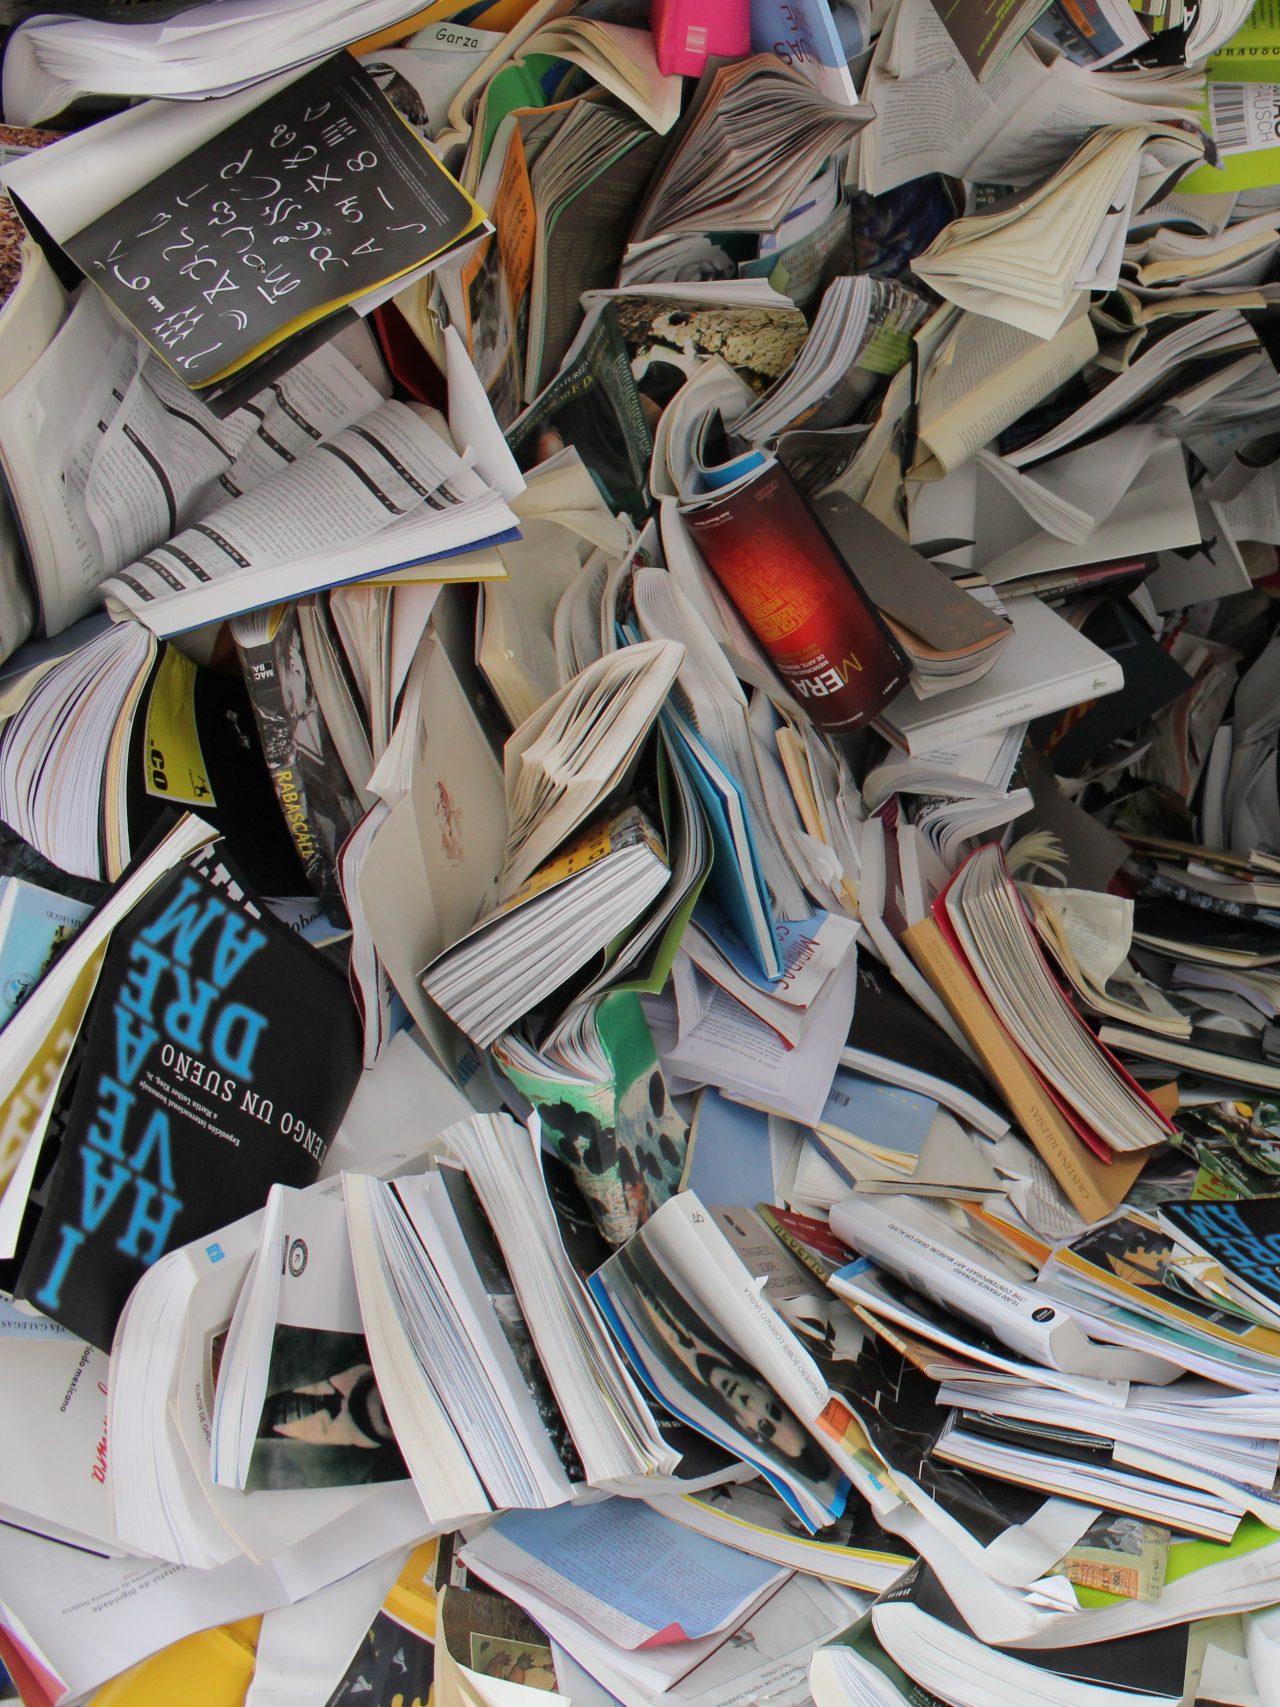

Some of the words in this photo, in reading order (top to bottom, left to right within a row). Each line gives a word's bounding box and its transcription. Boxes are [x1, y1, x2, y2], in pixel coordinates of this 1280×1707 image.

[434, 27, 479, 48] Garza
[252, 662, 265, 672] BA
[253, 668, 274, 680] MAC
[791, 650, 867, 705] MERA
[272, 768, 317, 860] RABASCALL
[111, 1006, 157, 1075] A
[137, 1079, 169, 1103] homenaje
[153, 1041, 239, 1108] SUEÑO
[153, 1075, 172, 1092] King,
[166, 1098, 209, 1128] internacional
[169, 1087, 192, 1105] Luther
[237, 1088, 279, 1125] UN
[206, 1120, 242, 1146] Exposición
[1026, 1104, 1059, 1150] IGLESIAS
[1053, 1148, 1090, 1200] CRISTINA
[36, 1223, 88, 1311] I
[759, 1311, 784, 1345] LORENZO
[55, 1367, 86, 1412] mexicano
[796, 1363, 827, 1404] CONGRESO
